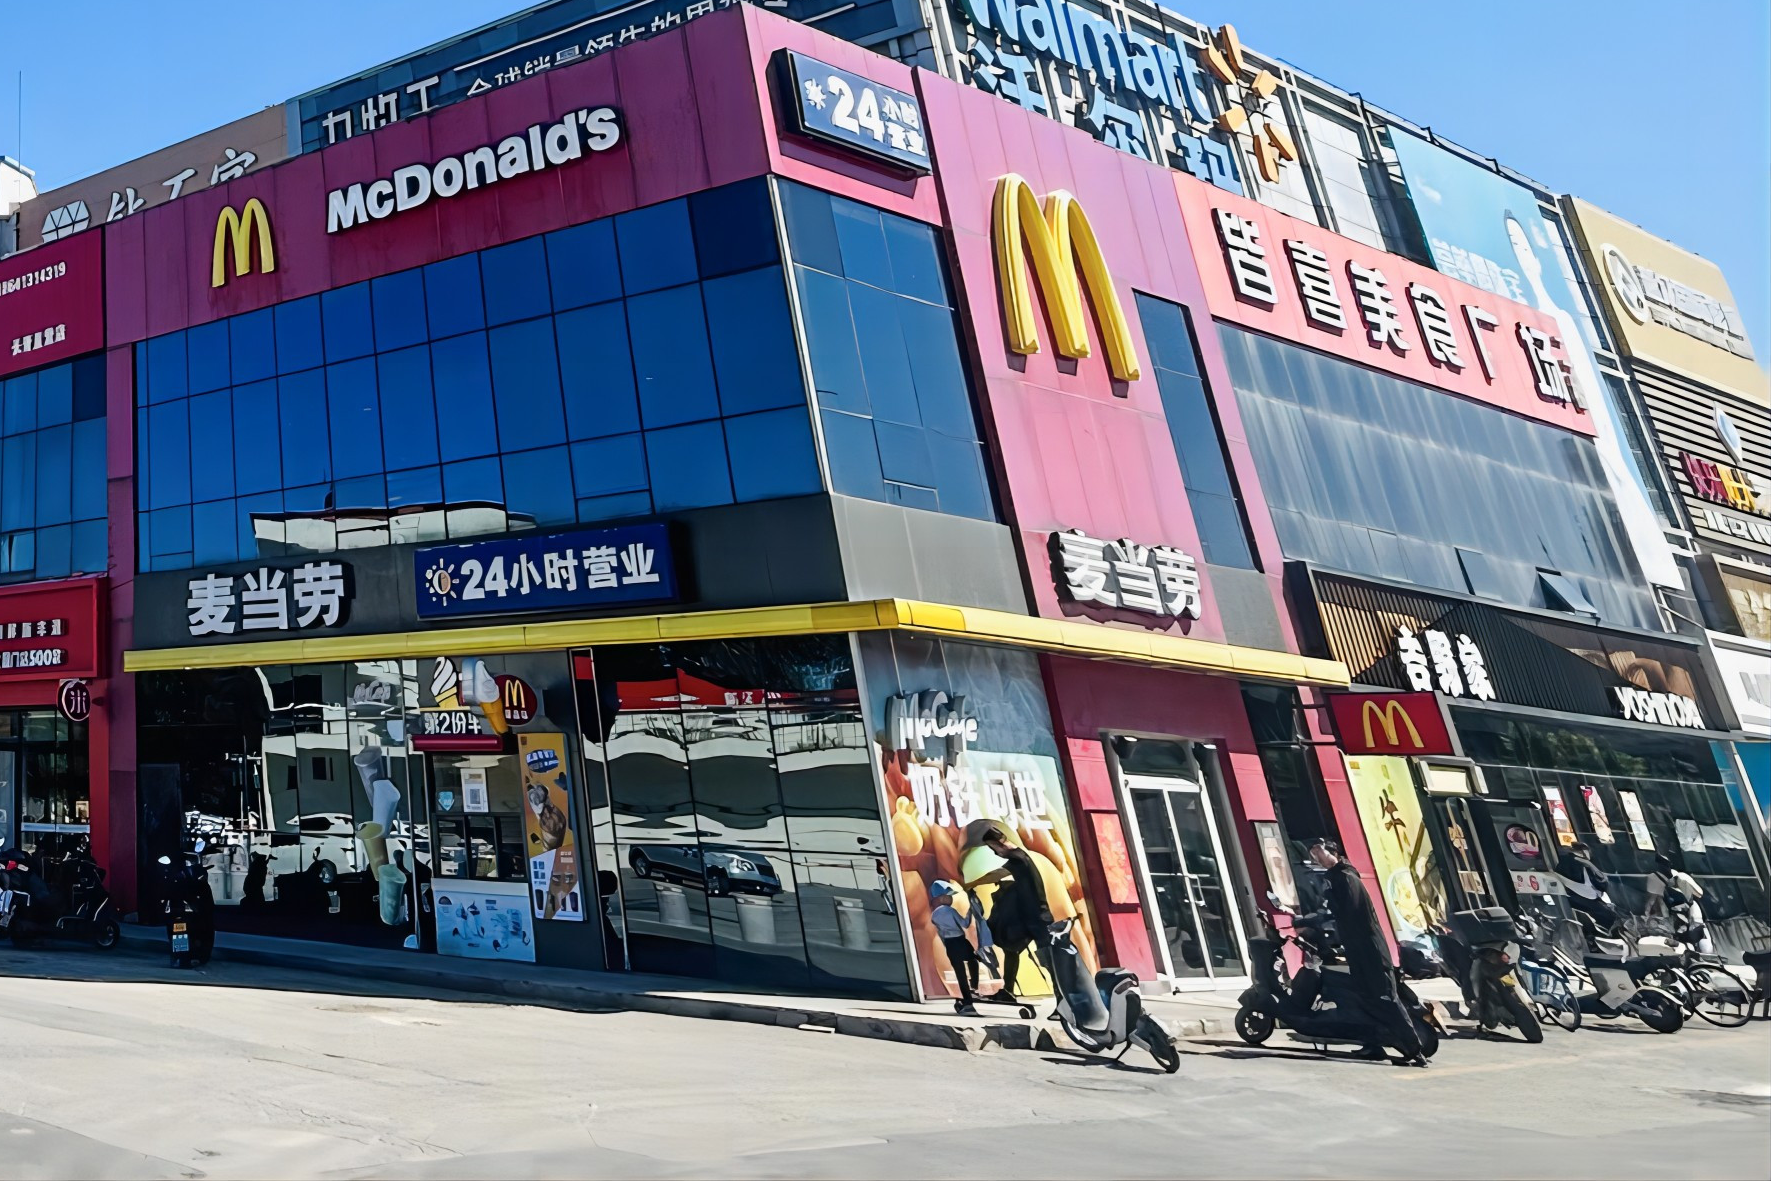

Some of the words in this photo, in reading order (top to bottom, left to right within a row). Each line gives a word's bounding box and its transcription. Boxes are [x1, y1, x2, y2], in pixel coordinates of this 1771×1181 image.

[327, 107, 620, 234] McDonald's
[1214, 208, 1588, 413] 皆喜美食广场
[187, 561, 344, 636] 麦当劳
[460, 543, 660, 601] 24小时营业
[1058, 528, 1202, 620] 麦当劳
